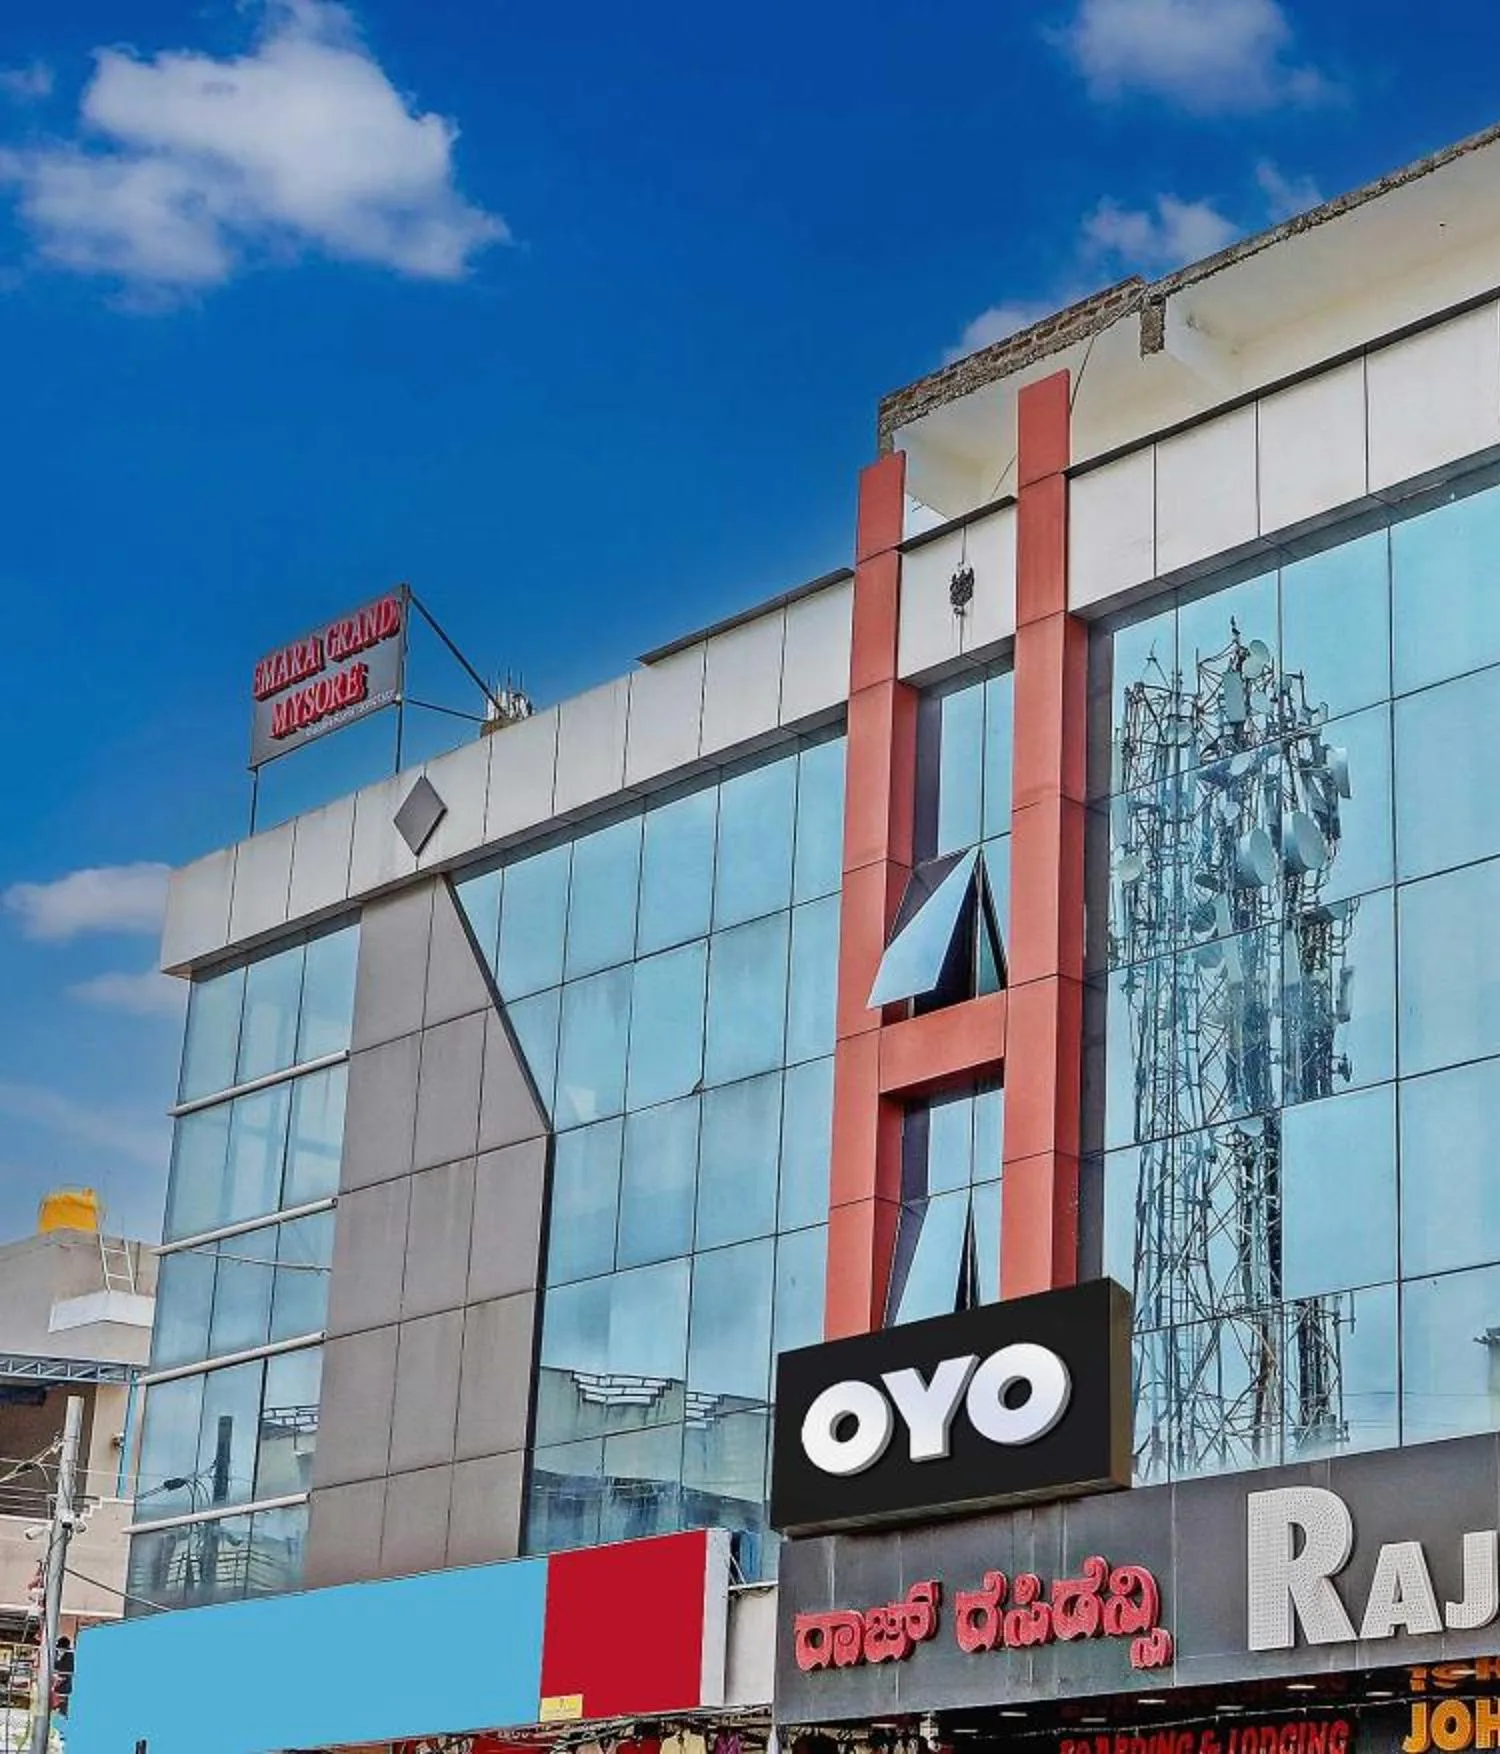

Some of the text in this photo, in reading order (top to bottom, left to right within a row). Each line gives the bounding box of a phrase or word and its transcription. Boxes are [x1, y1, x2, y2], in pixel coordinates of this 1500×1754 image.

[326, 597, 400, 661] GRAND
[270, 663, 368, 737] MYSORE
[801, 1342, 1071, 1477] OYO
